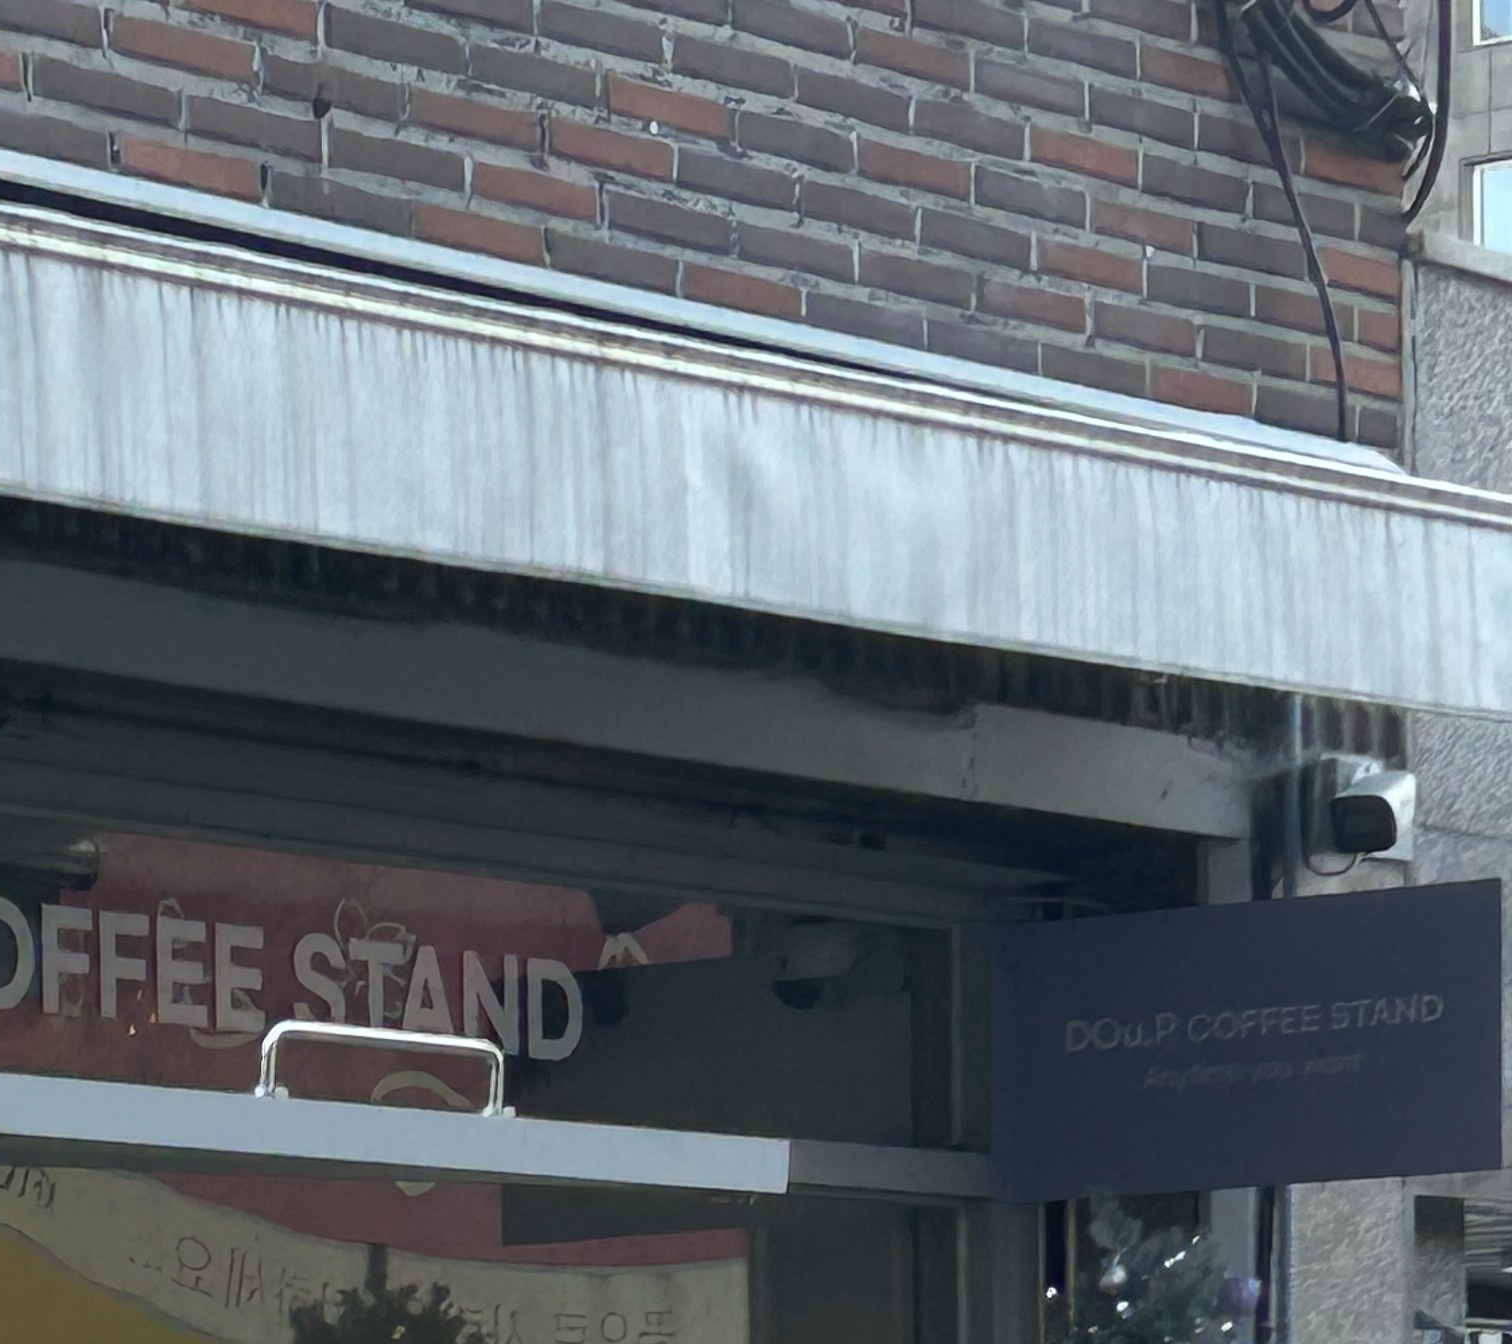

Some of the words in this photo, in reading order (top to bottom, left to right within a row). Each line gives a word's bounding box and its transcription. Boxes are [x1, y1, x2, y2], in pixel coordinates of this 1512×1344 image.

[292, 932, 584, 1061] STAND
[1187, 1003, 1322, 1043] COFFEE
[1330, 993, 1445, 1030] STAND
